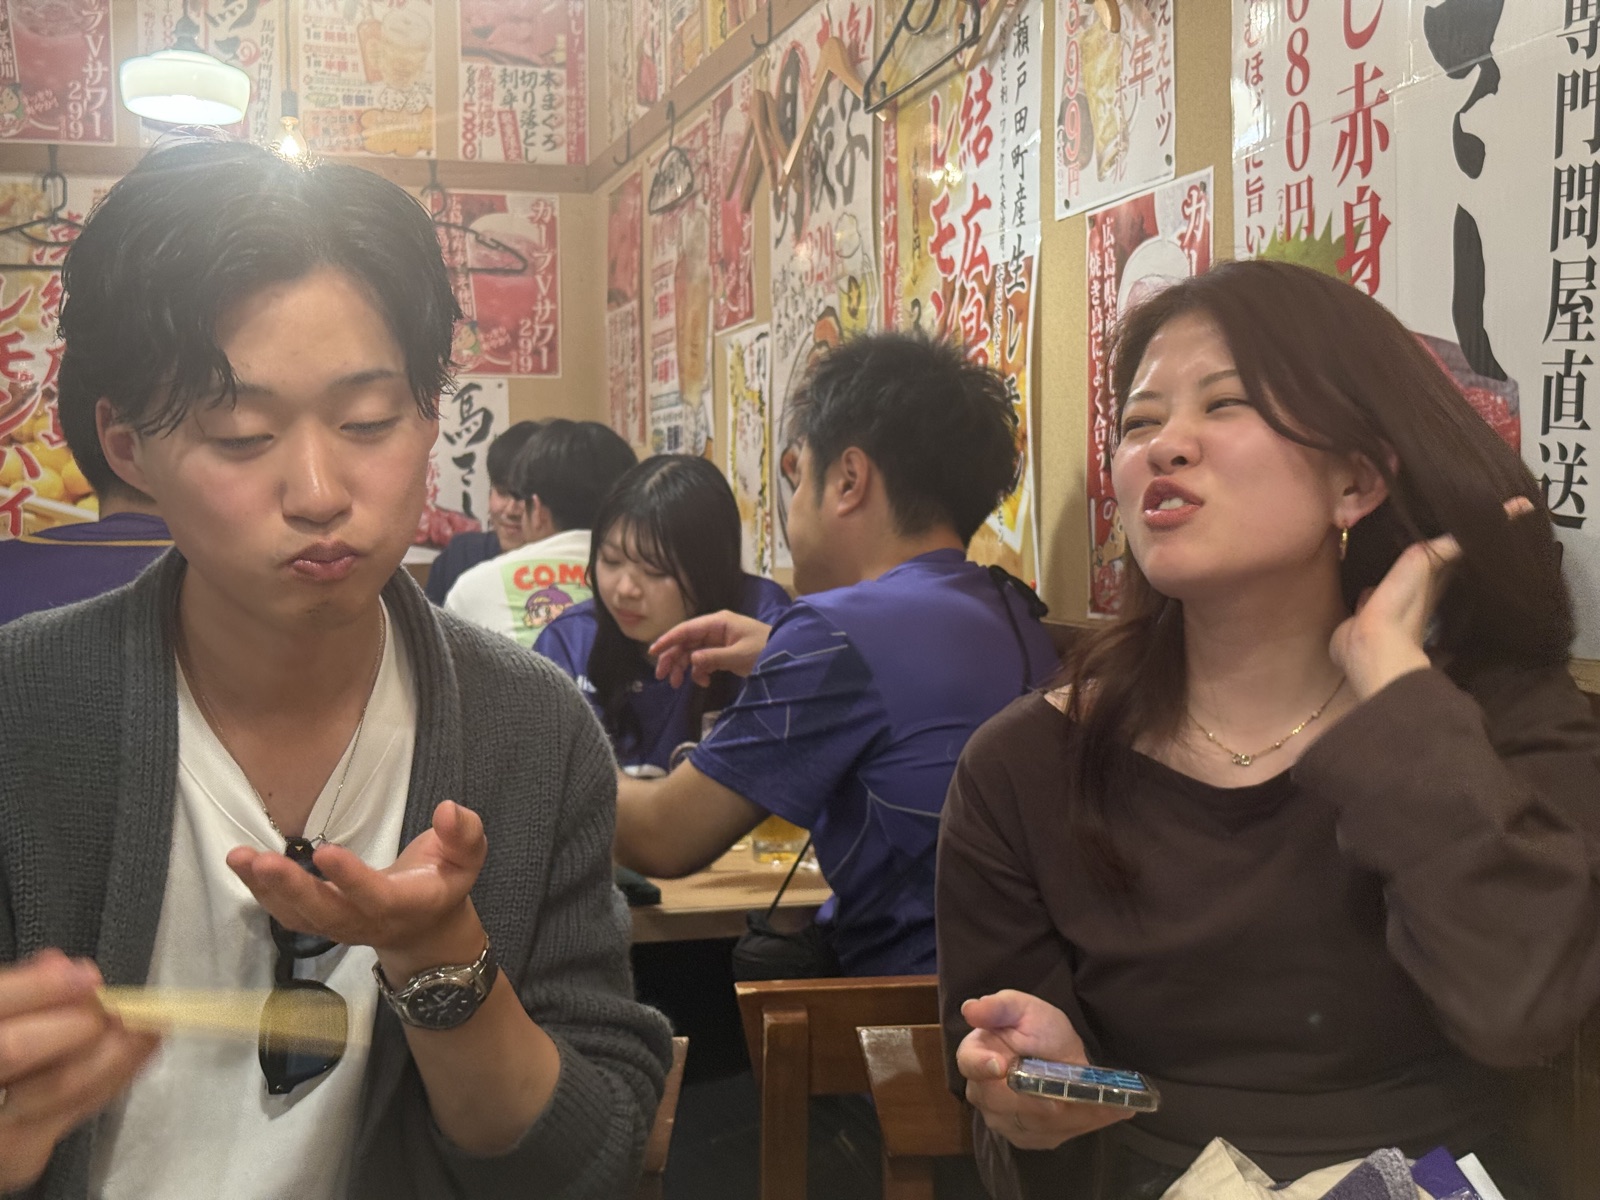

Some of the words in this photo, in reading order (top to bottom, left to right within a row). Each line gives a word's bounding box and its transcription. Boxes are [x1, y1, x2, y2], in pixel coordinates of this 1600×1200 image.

[520, 71, 538, 164] 切り落とし
[540, 70, 557, 152] 本まぐろ
